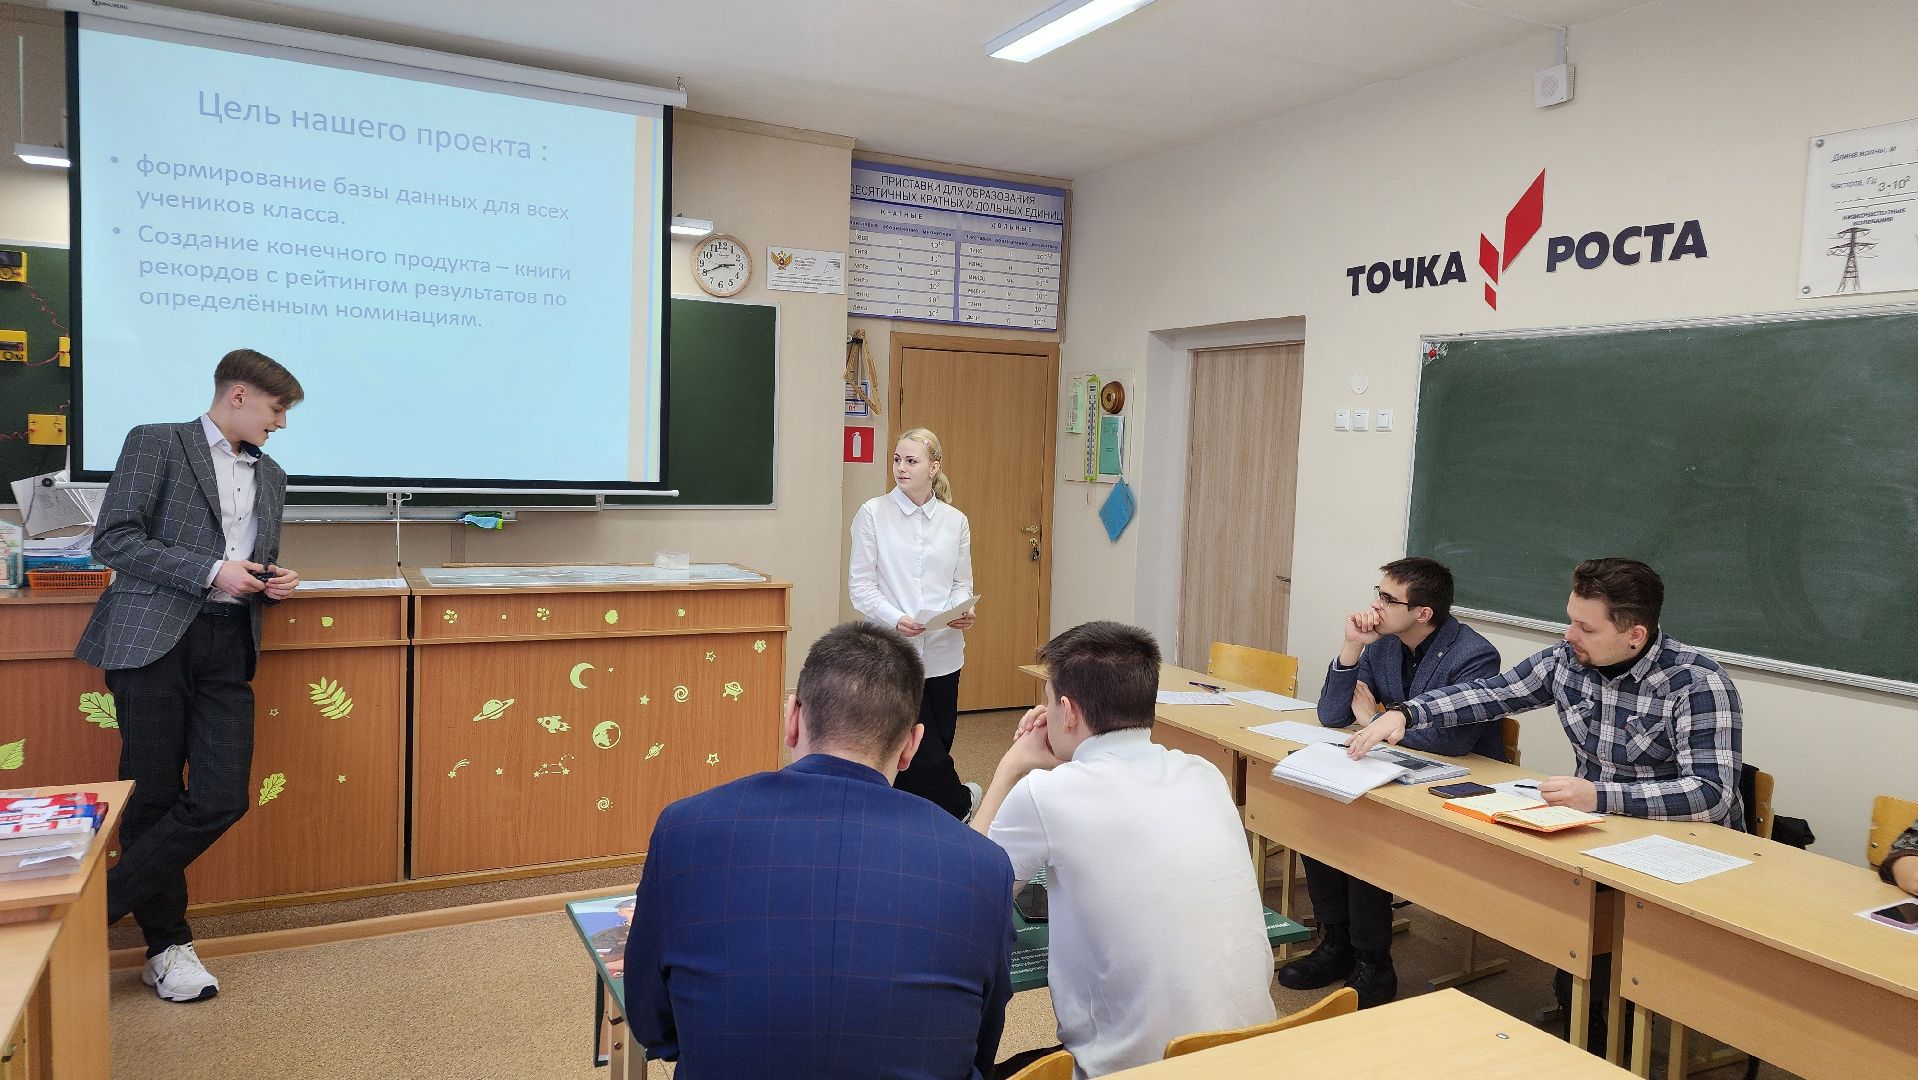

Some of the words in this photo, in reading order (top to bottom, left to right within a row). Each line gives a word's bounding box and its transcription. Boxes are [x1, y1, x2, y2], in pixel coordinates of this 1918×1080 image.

[199, 90, 281, 125] Цель
[292, 110, 407, 142] нашего
[417, 127, 531, 160] проекта
[136, 153, 326, 193] формирование
[333, 176, 389, 200] базы
[396, 188, 478, 210] данных
[483, 199, 520, 215] для
[527, 203, 569, 220] всех
[881, 175, 941, 193] ПРИСТАВКИ
[943, 184, 964, 197] ДЛЯ
[965, 187, 1036, 206] ОБРАЗОВАНИЯ
[136, 190, 255, 215] учеников
[263, 203, 346, 225] класса.
[920, 195, 965, 209] КРАТНЫХ
[967, 199, 973, 208] И
[976, 201, 1023, 215] ДОЛЬНЫХ
[1025, 207, 1064, 222] ЕДИНИЦ
[138, 224, 259, 252] Создание
[267, 239, 386, 264] конечного
[395, 252, 491, 274] продукта
[516, 263, 571, 281] книги
[703, 251, 712, 259] 10
[710, 244, 718, 252] 11
[718, 242, 727, 250] 12
[730, 246, 734, 254] 1
[736, 254, 740, 262] 2
[1347, 250, 1468, 297] ТОЧКА
[1546, 219, 1708, 273] РОСТА
[700, 259, 704, 267] 9
[739, 263, 743, 271] 3
[139, 259, 258, 284] рекордов
[266, 270, 278, 283] с
[285, 270, 408, 295] рейтингом
[415, 281, 537, 305] результатов
[543, 292, 567, 306] по
[139, 290, 328, 318] определённым
[336, 304, 482, 328] номинациям.
